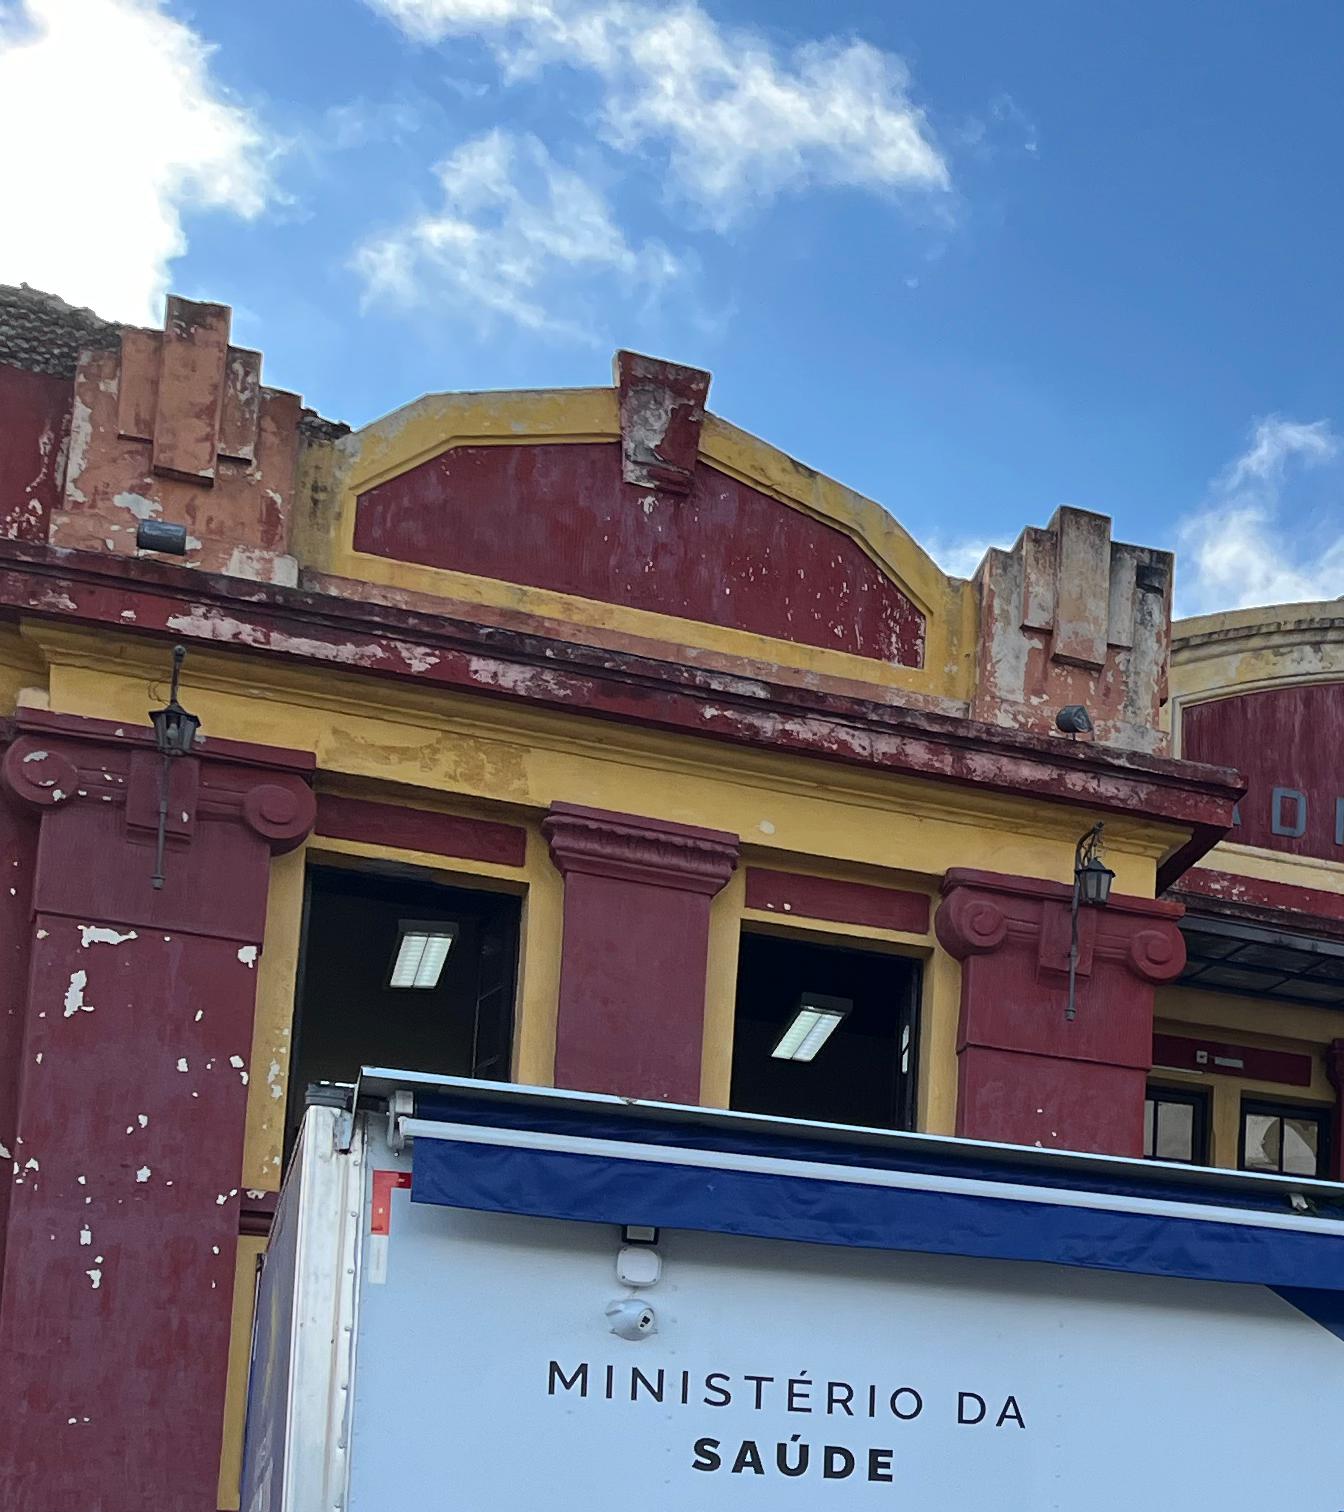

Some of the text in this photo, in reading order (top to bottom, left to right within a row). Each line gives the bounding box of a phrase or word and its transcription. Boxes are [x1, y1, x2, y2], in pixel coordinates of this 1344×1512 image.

[548, 1360, 1026, 1429] MINISTÉRIO DA
[691, 1433, 894, 1483] SAÚDE
